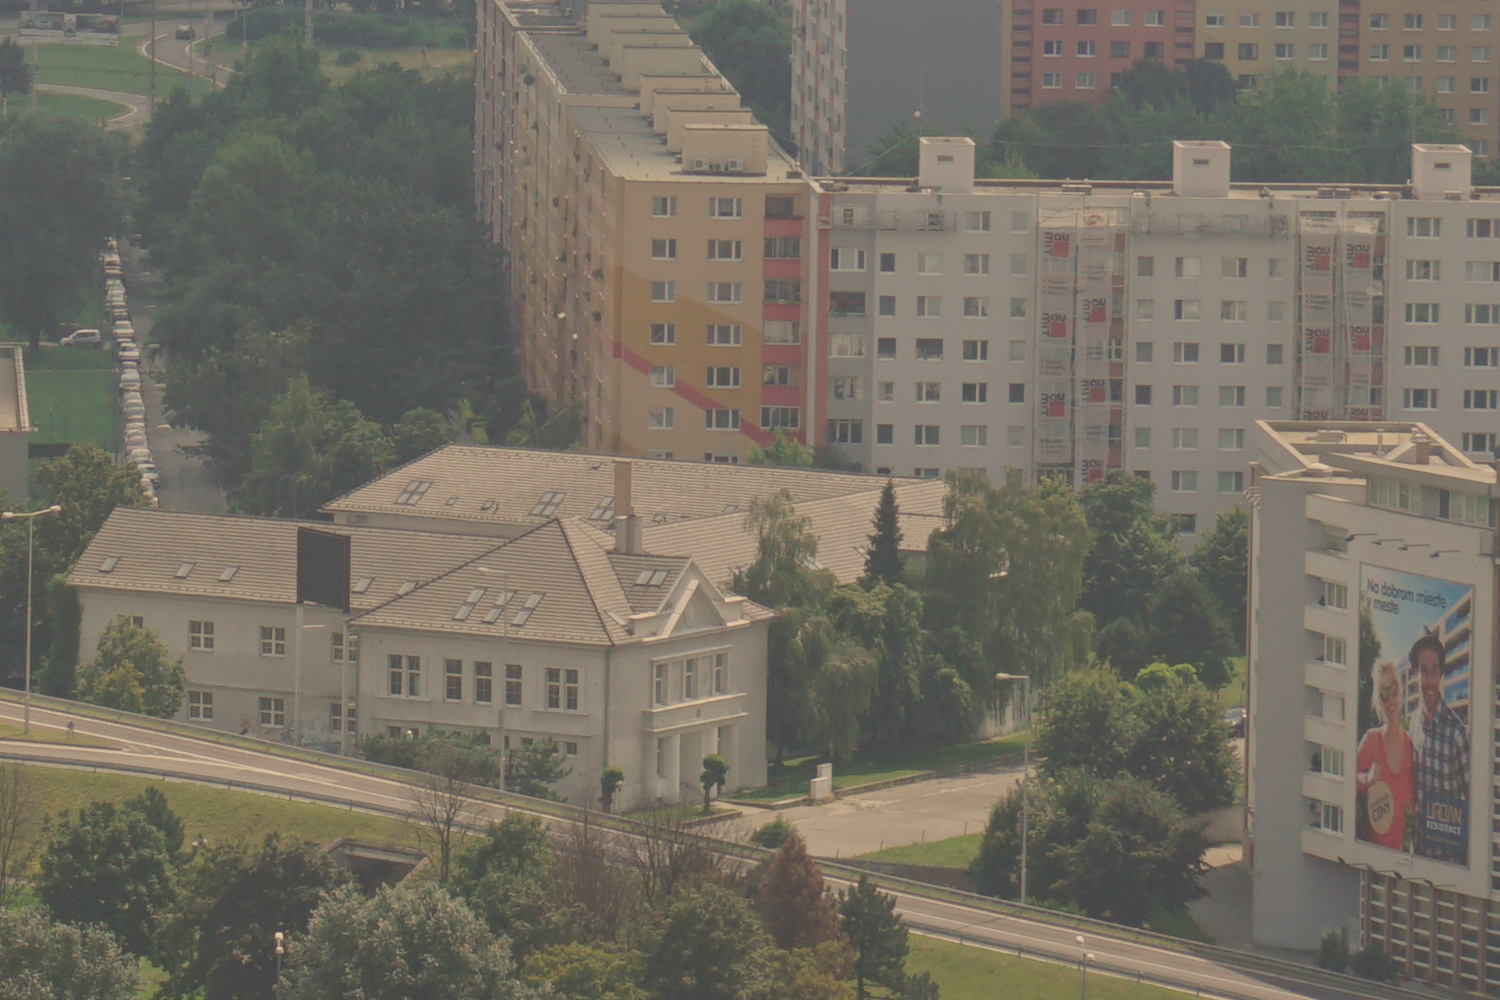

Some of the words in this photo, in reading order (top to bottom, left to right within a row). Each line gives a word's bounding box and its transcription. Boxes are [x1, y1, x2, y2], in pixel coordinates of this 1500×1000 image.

[1381, 581, 1414, 603] dobrom
[1416, 589, 1447, 609] mieste
[1373, 598, 1399, 615] meste
[1426, 800, 1462, 825] URBAN
[1426, 820, 1462, 836] RESIDENCE
